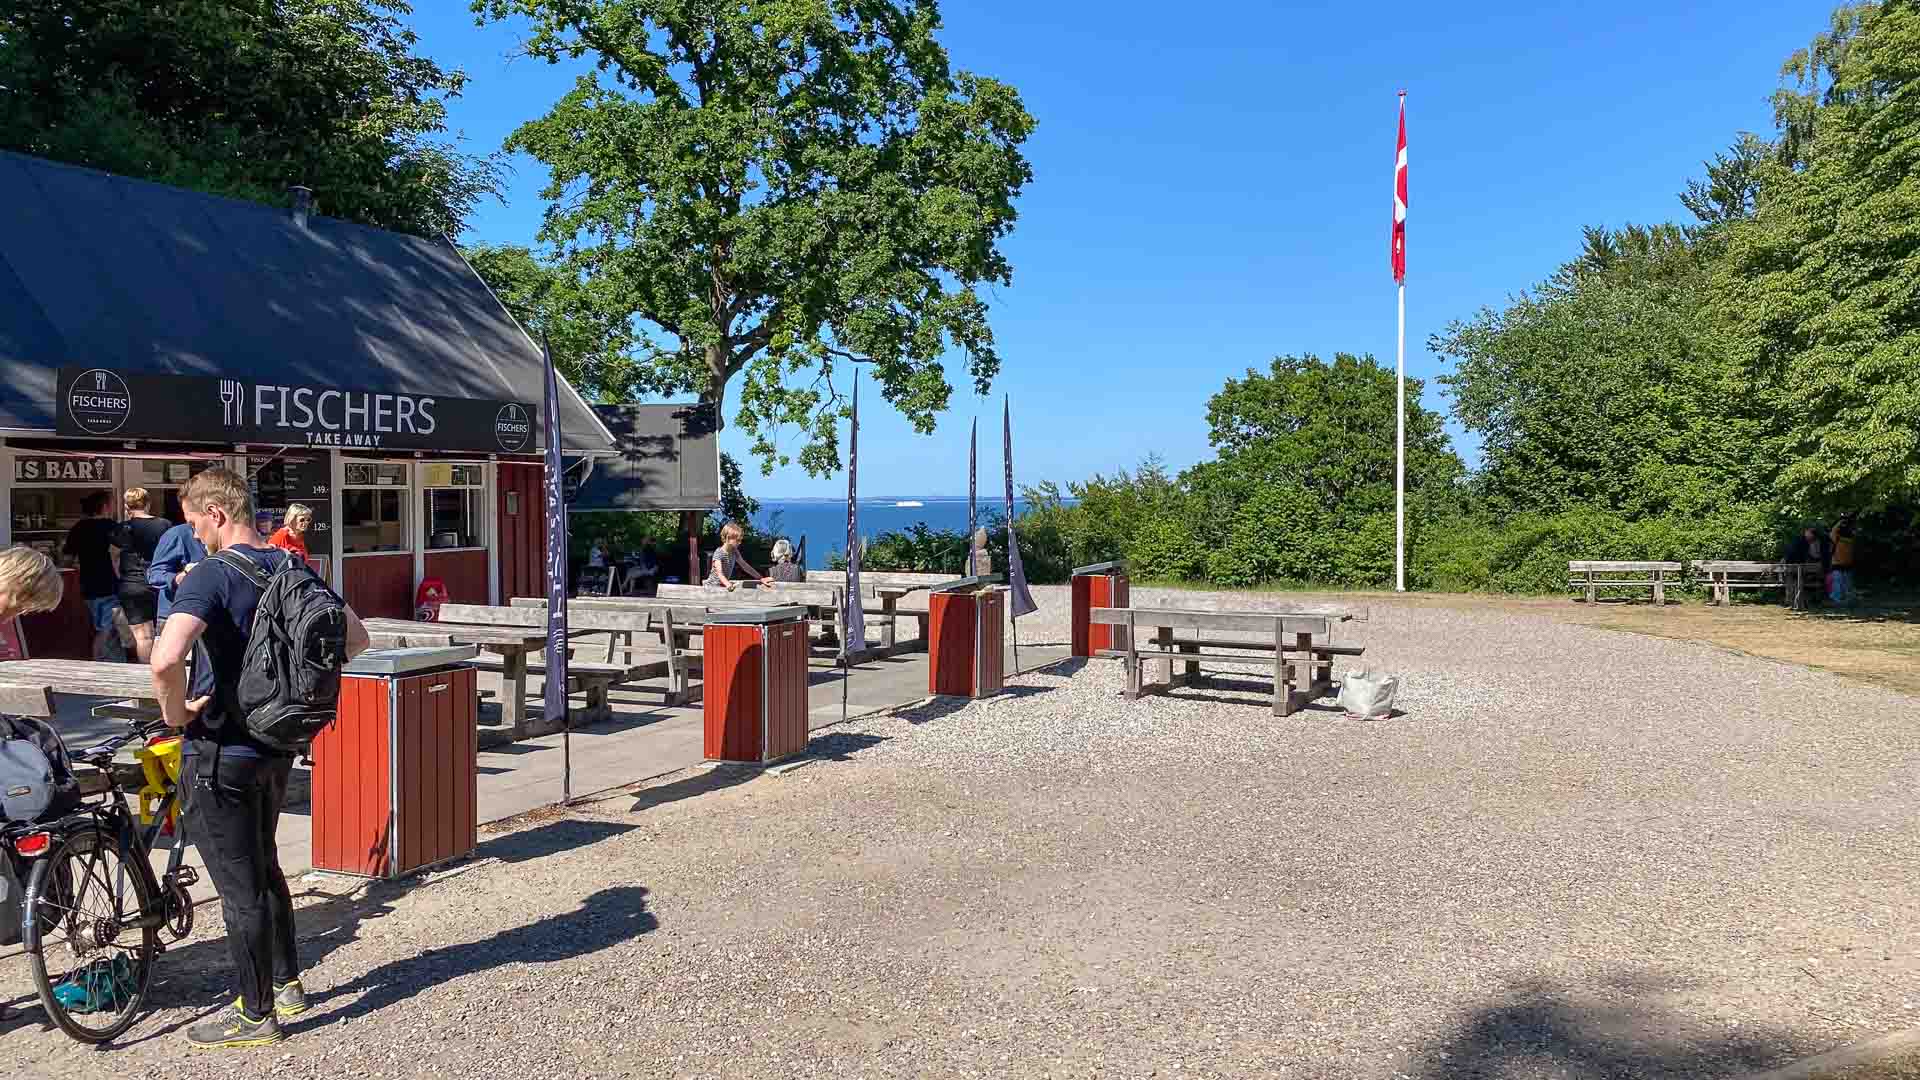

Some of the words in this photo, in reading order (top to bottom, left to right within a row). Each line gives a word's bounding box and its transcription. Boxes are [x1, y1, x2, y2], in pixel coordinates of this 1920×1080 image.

[73, 395, 127, 409] FISCHERS
[255, 384, 436, 435] FISCHERS
[497, 423, 528, 433] FISCHERS
[305, 431, 341, 445] TAKE
[344, 434, 381, 447] AWAY
[15, 460, 39, 479] IS
[45, 461, 93, 479] BAR
